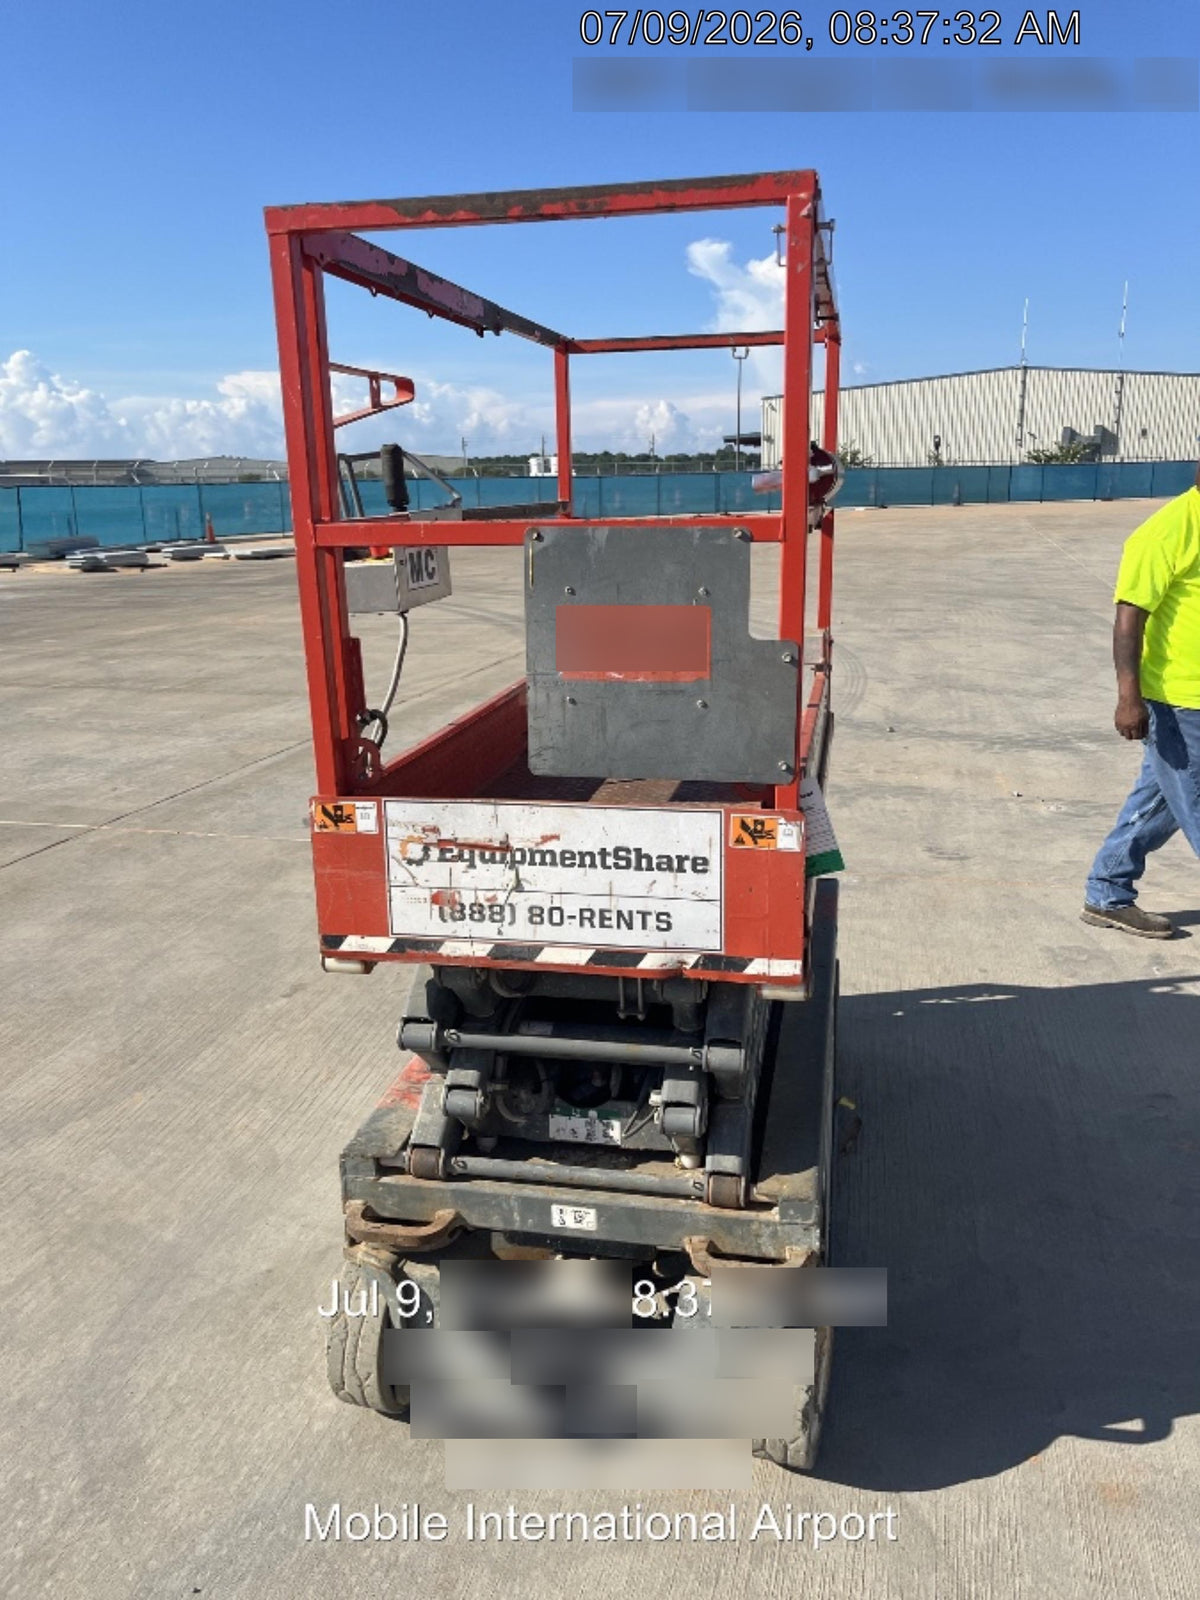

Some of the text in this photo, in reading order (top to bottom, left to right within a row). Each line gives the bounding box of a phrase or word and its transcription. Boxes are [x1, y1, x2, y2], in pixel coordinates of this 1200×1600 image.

[408, 549, 436, 584] MC
[437, 845, 710, 875] EquipmentShare
[438, 901, 673, 933] (888) 80-RENTS
